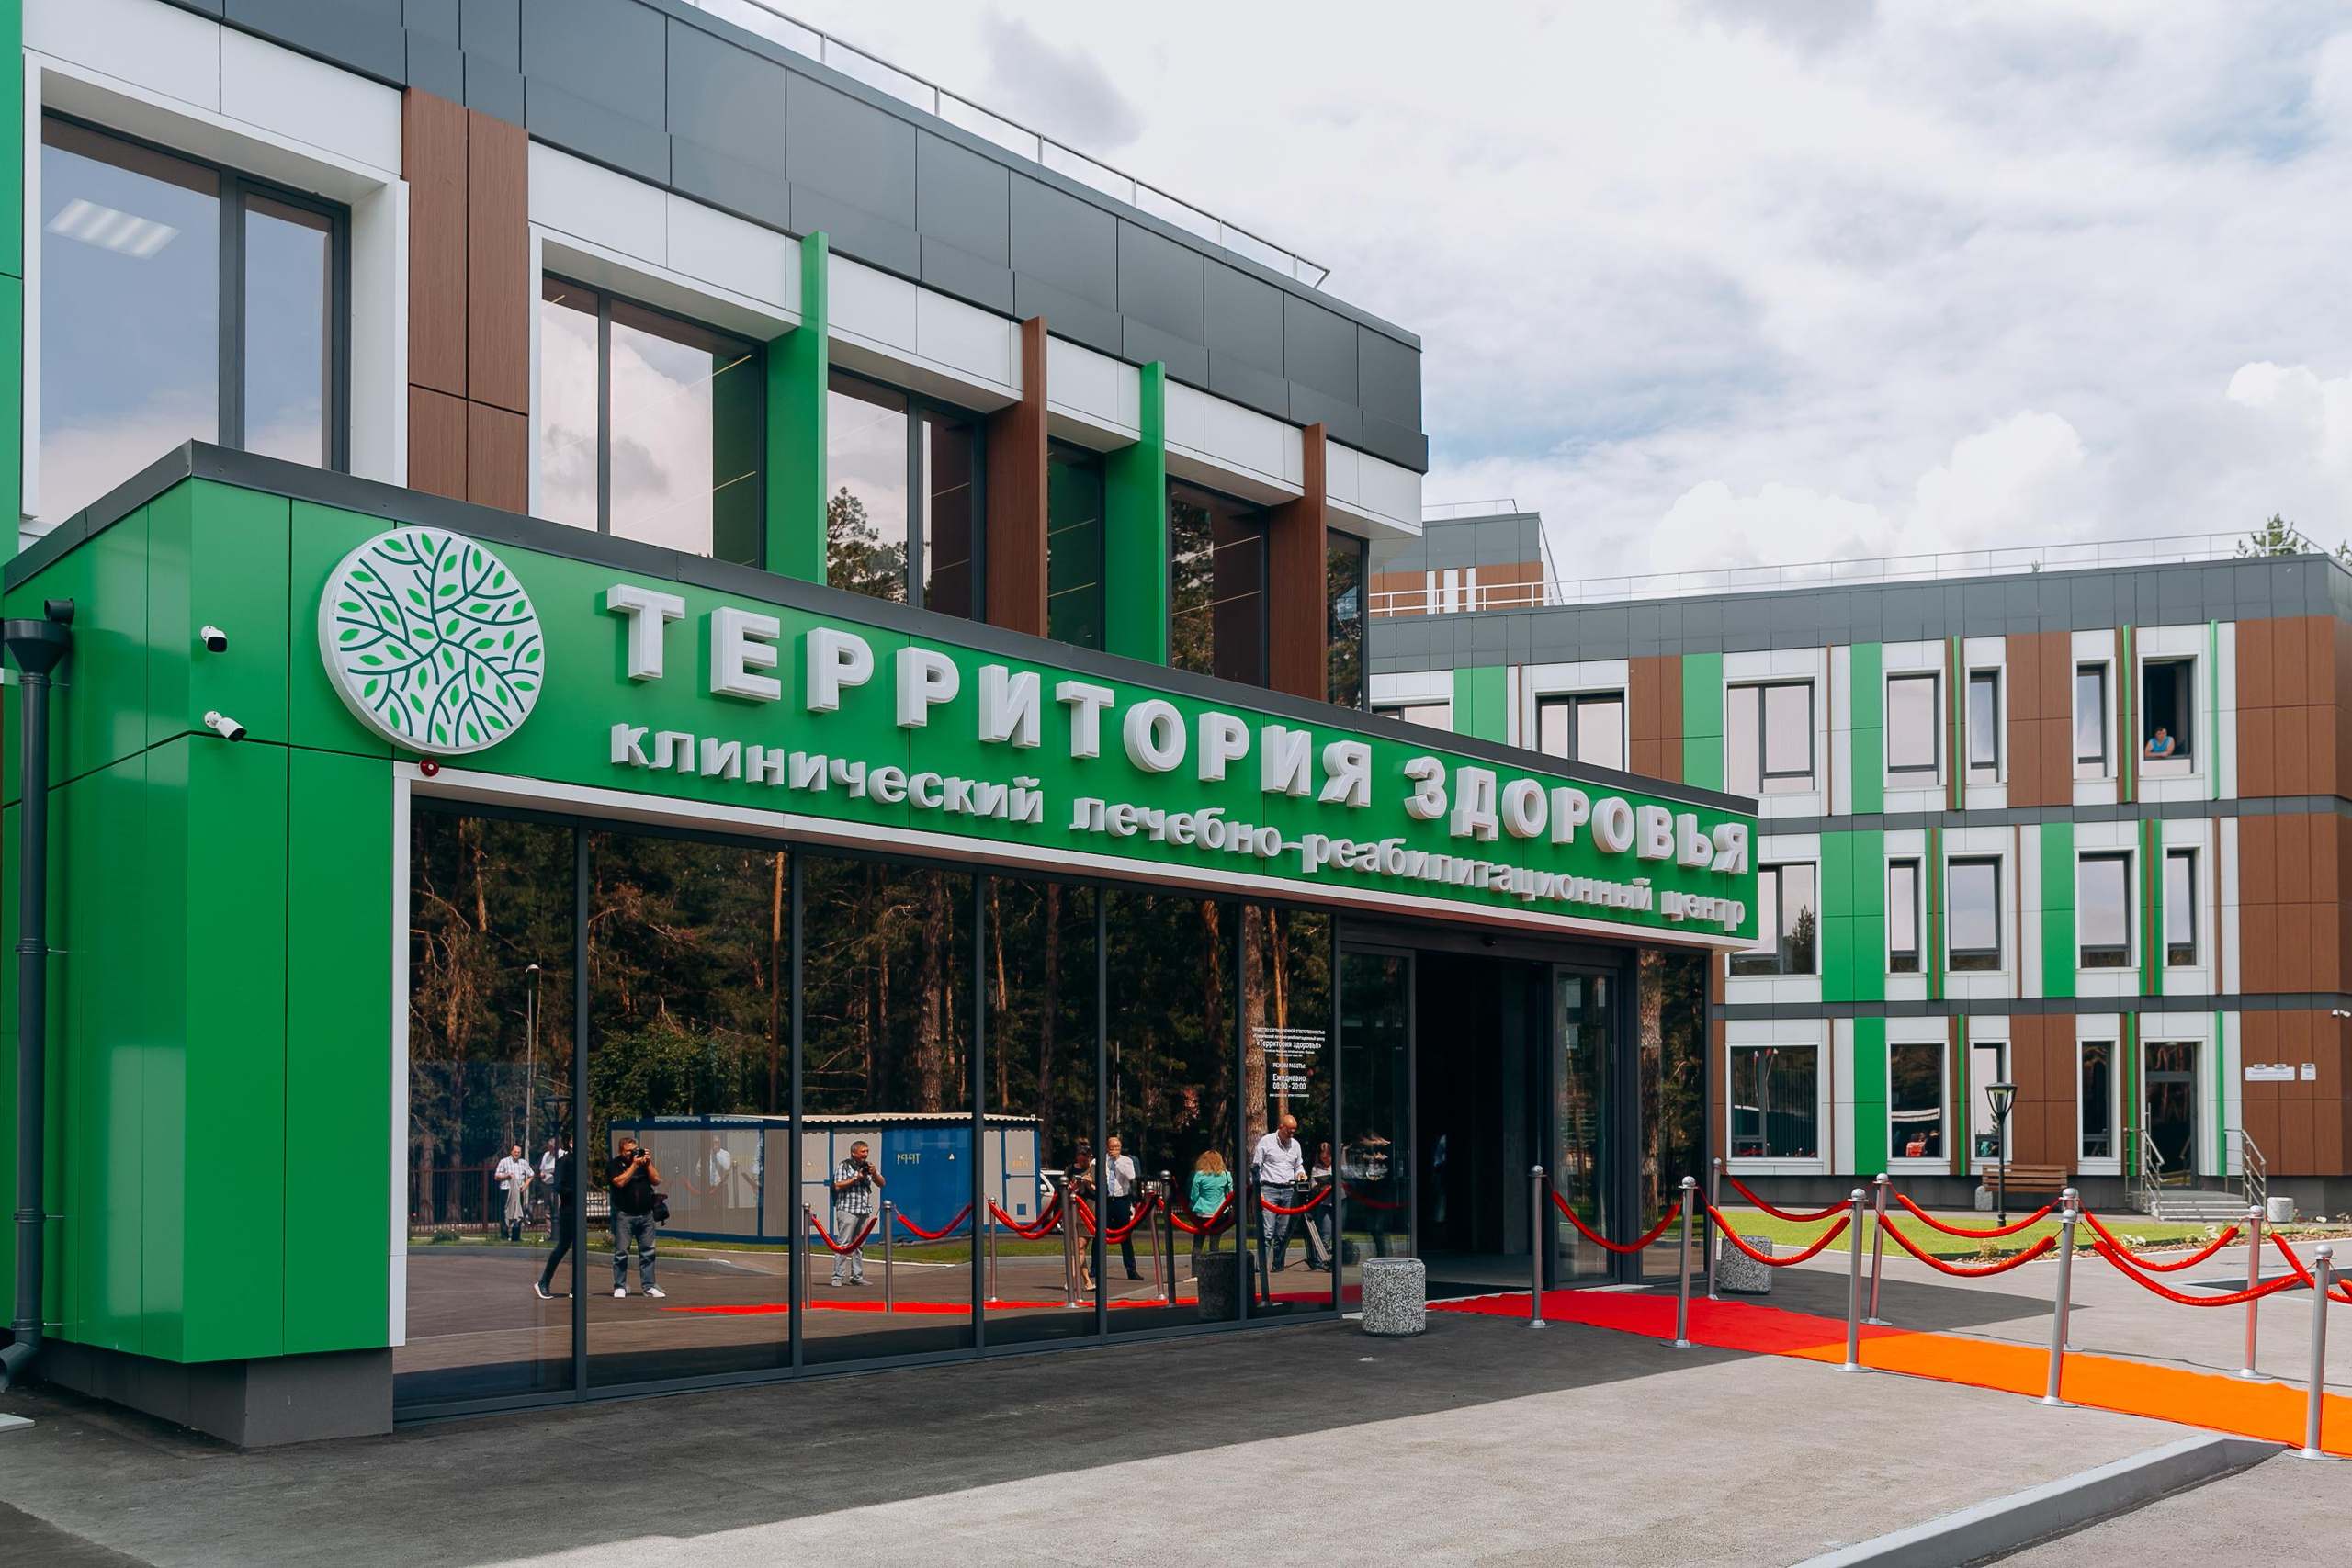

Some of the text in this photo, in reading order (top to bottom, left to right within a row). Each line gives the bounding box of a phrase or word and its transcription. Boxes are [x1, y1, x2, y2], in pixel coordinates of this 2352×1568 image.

[606, 583, 1749, 875] ТЕРРИТОРИЯ ЗДОРОВЬЯ
[610, 723, 1747, 931] клинический лечебно-реабилитационный центр
[1272, 1074, 1306, 1082] Ежедневно
